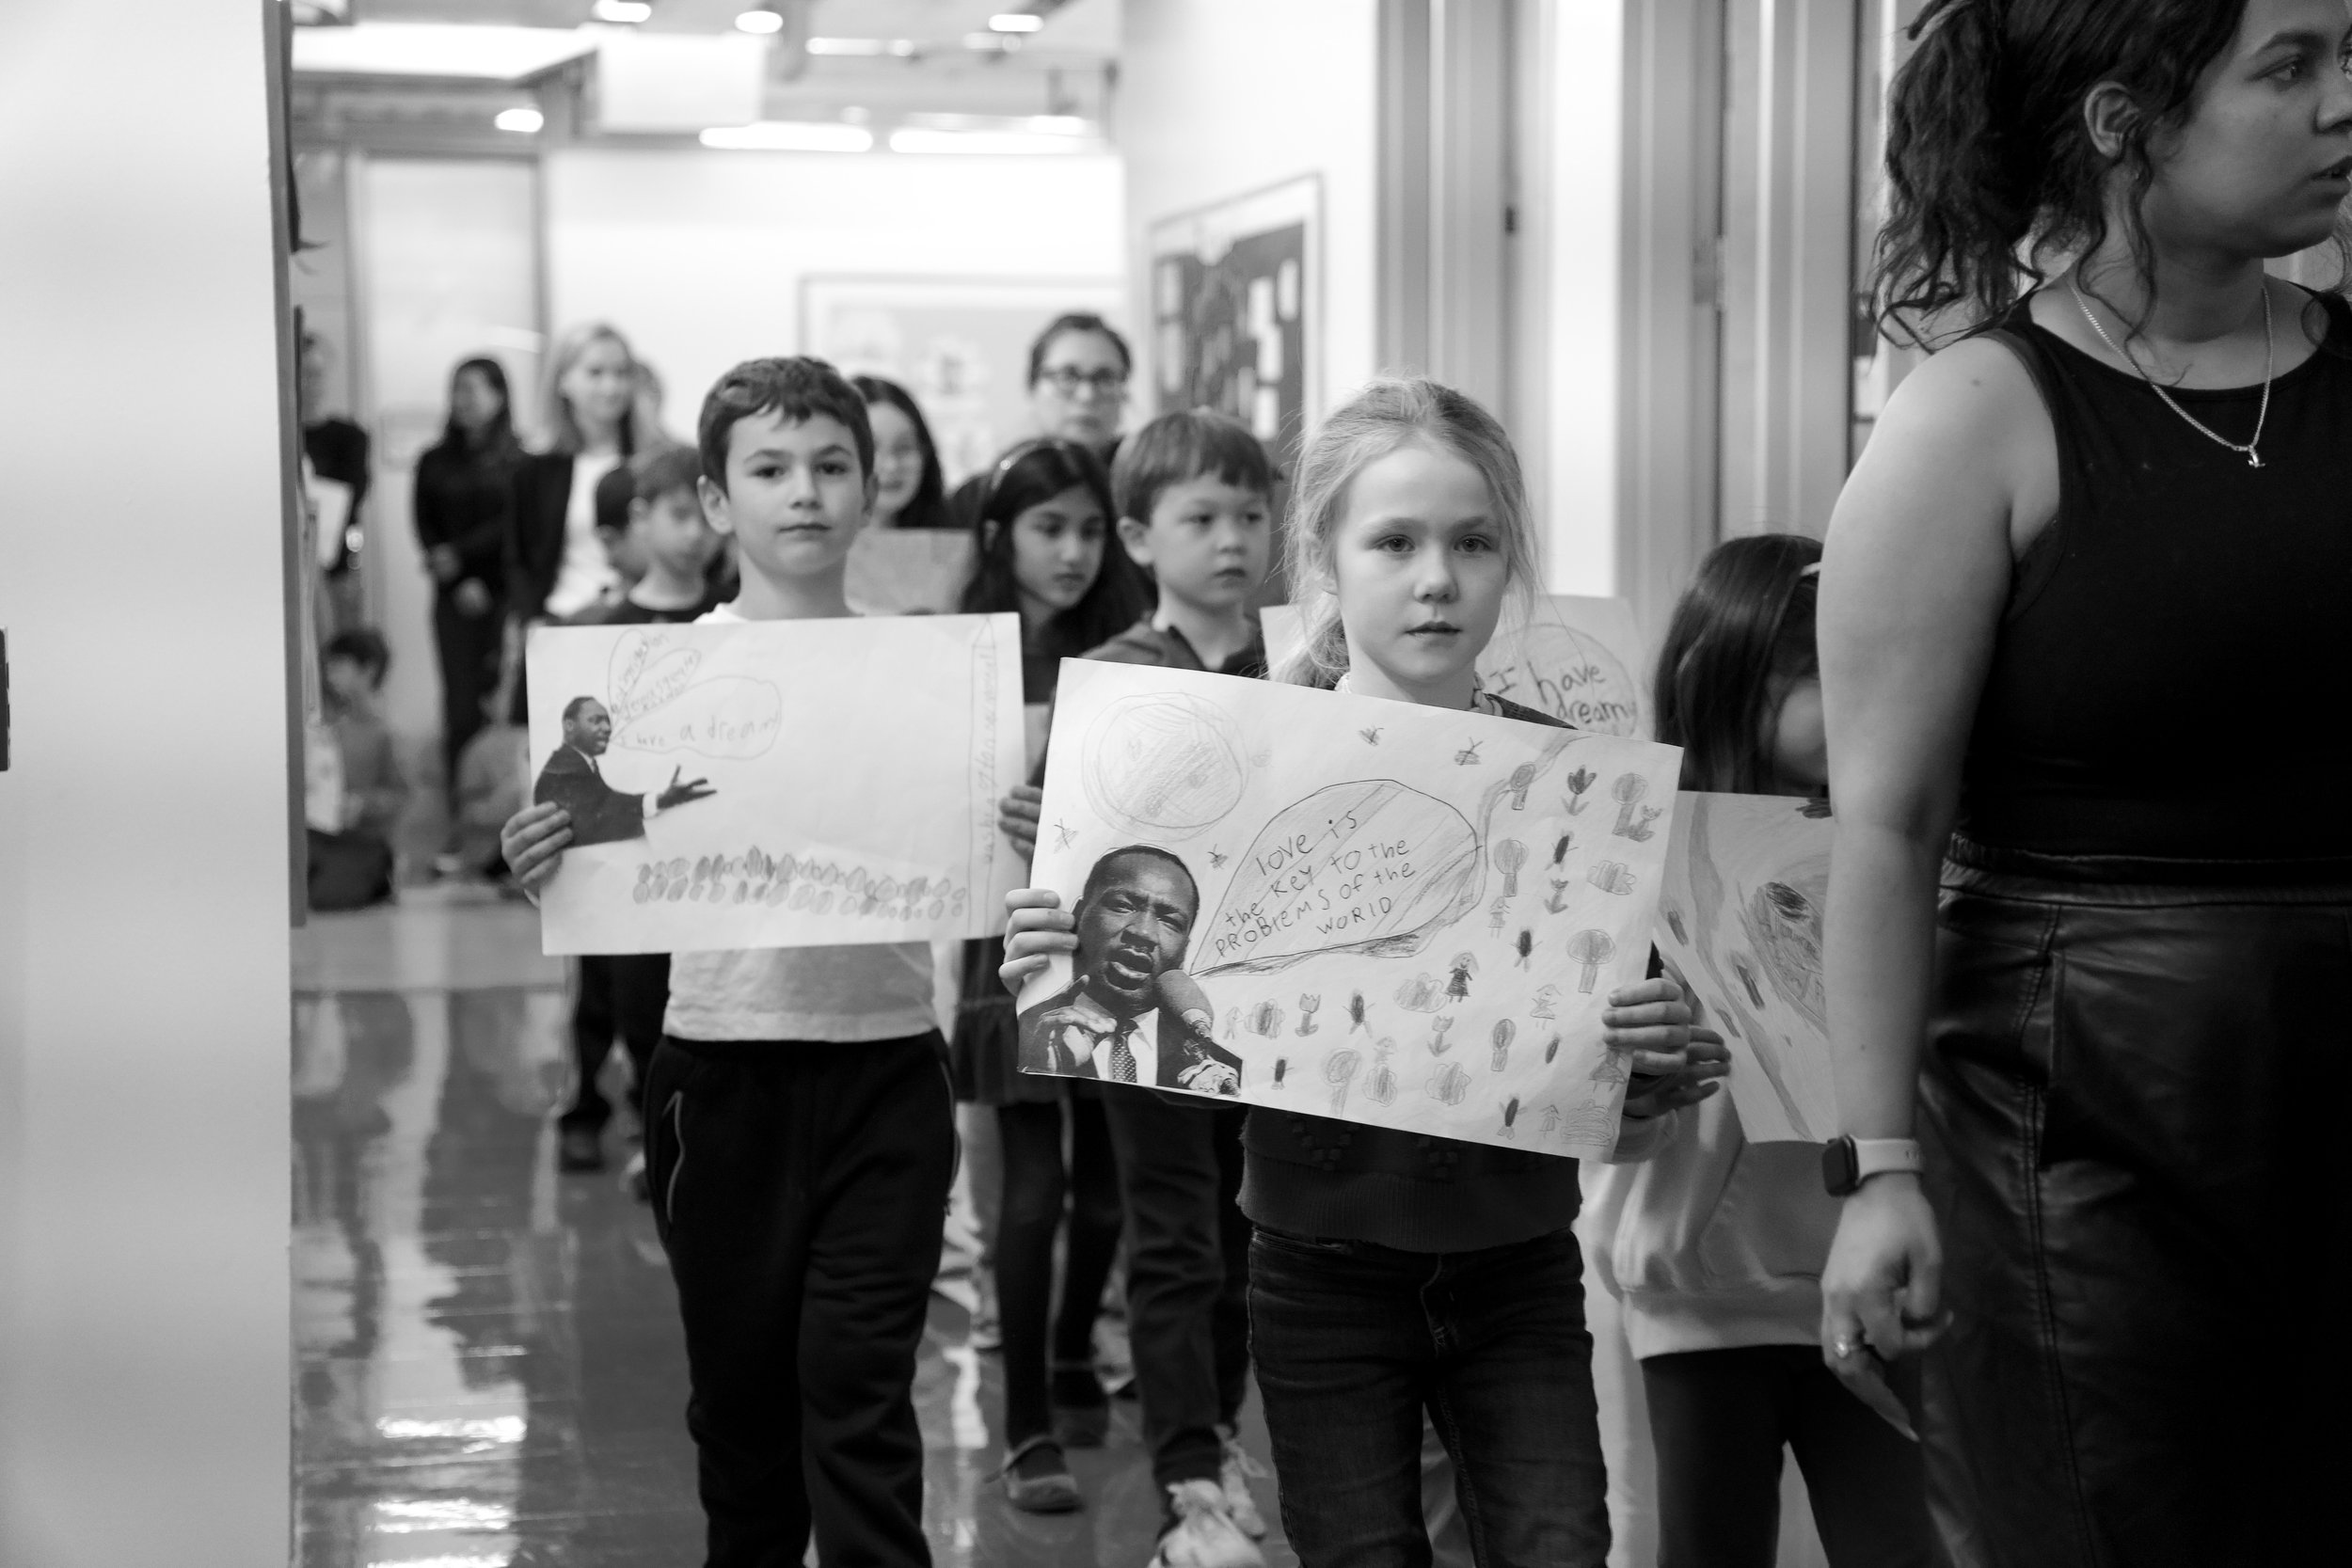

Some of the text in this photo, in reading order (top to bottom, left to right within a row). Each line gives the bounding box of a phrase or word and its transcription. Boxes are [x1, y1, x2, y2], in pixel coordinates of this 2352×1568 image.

[1488, 660, 1607, 706] I have
[1255, 810, 1358, 877] love is
[1225, 902, 1264, 927] the
[1369, 839, 1410, 860] the
[1339, 873, 1364, 900] of
[1374, 862, 1417, 885] the
